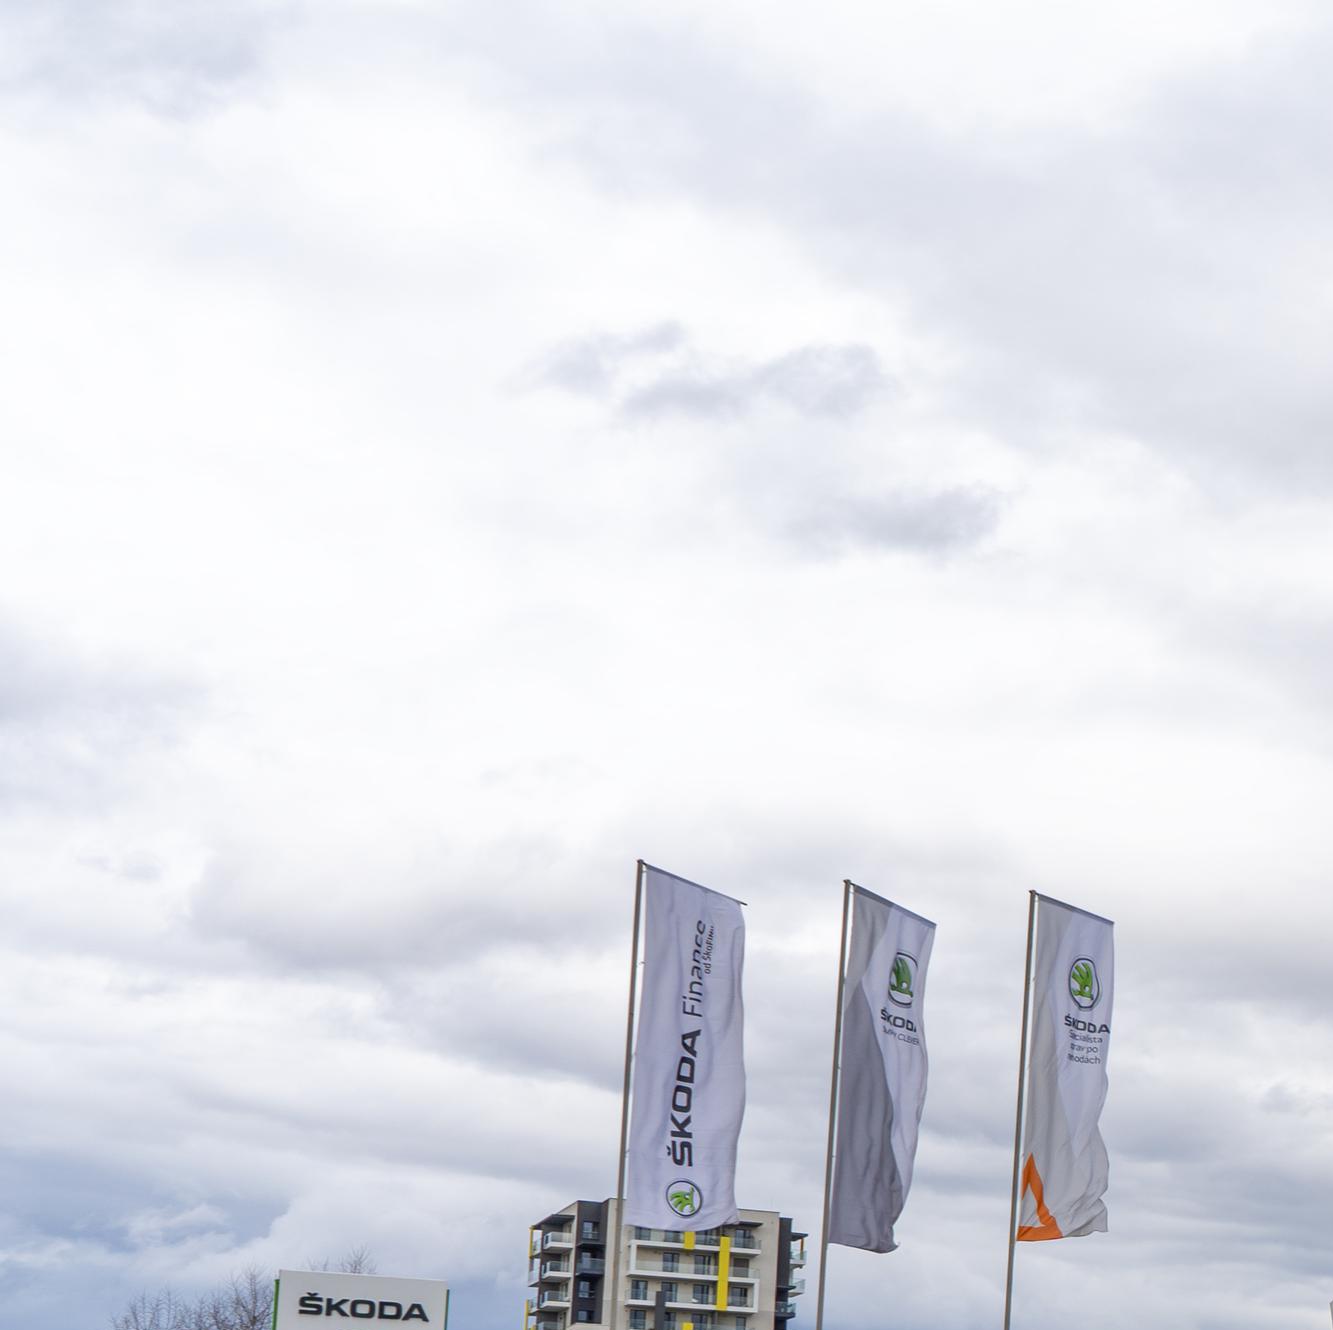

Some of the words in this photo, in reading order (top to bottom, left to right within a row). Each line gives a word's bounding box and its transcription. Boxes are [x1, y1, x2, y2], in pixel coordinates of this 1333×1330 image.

[682, 920, 705, 1017] Finance
[1086, 1046, 1098, 1054] po
[666, 1029, 702, 1167] ŠKODA
[298, 1292, 430, 1322] ŠKODA
